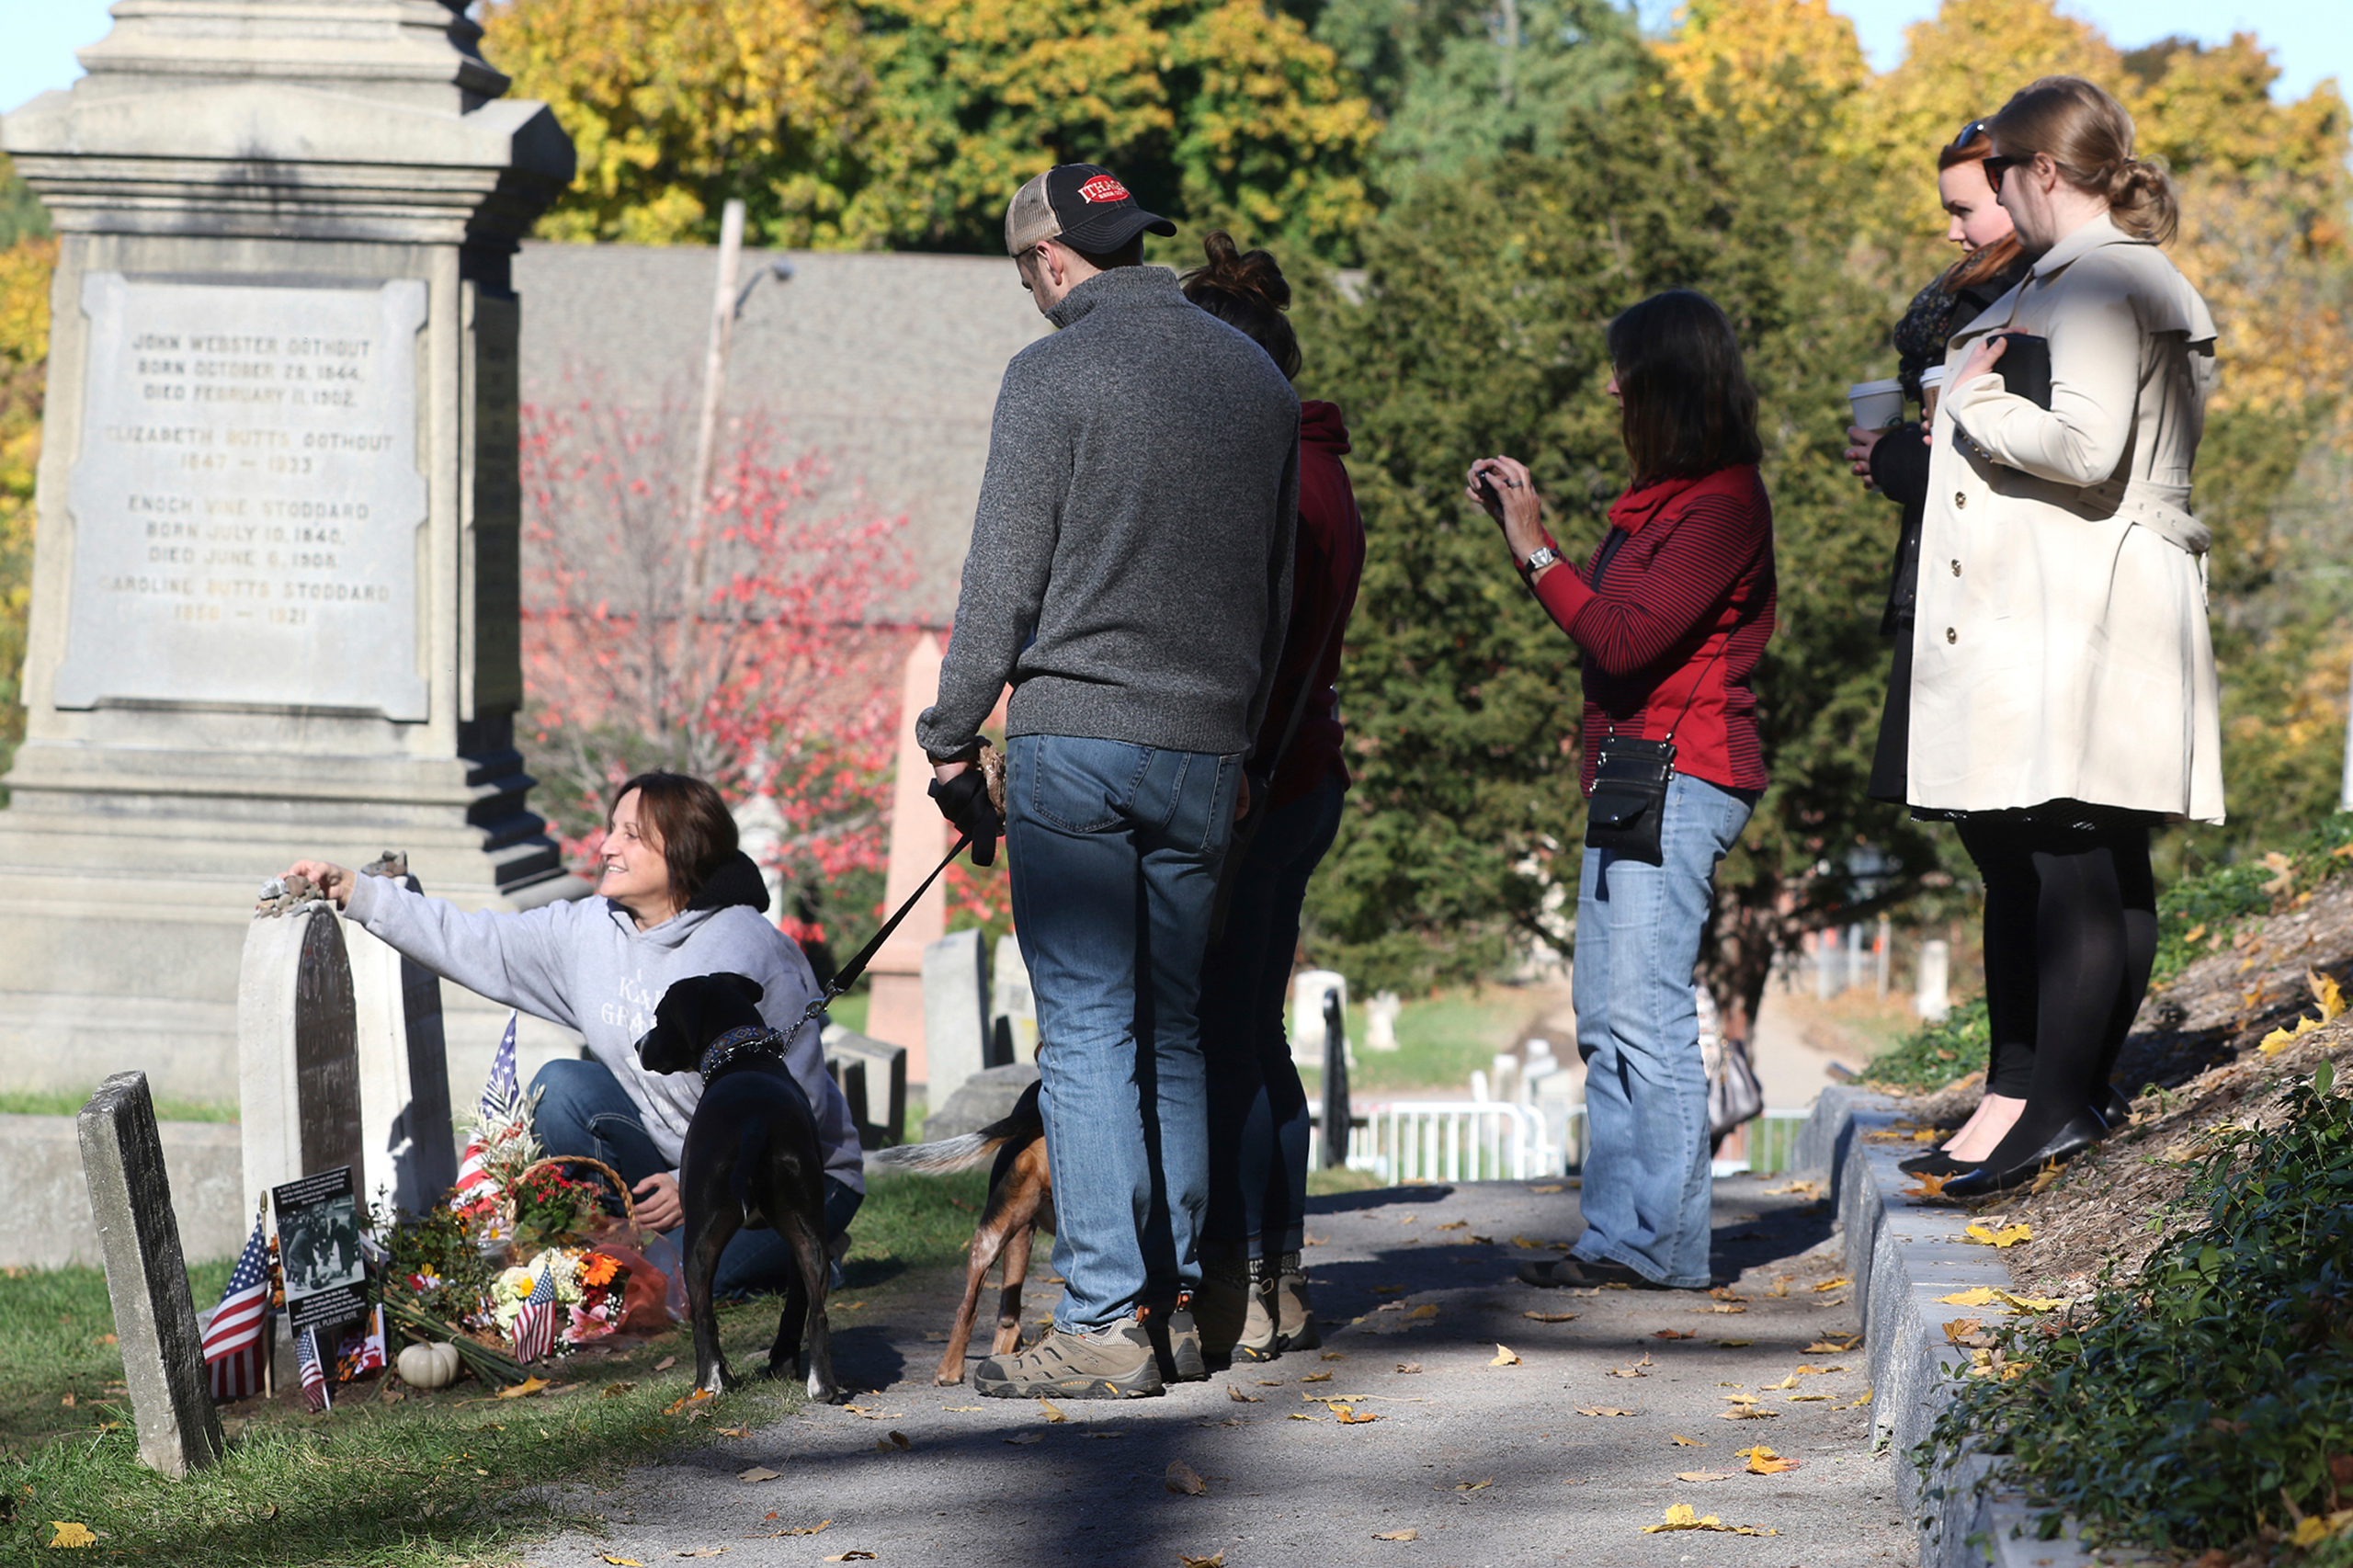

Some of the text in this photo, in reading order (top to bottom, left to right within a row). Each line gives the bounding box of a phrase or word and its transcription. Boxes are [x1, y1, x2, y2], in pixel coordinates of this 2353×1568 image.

[131, 333, 180, 351] JOHN
[190, 335, 278, 355] WEBSTER
[138, 358, 186, 375] BORN
[194, 359, 275, 380] OCTOBER
[143, 383, 185, 402] DIED
[193, 384, 287, 404] FEBRUARY
[128, 494, 193, 514] ENOCH
[261, 499, 369, 520] STODDARD
[145, 520, 199, 539] BORN
[206, 524, 257, 542] JULY
[148, 546, 195, 564] DIED
[202, 548, 256, 567] JUNE
[283, 581, 391, 602] STODDARD
